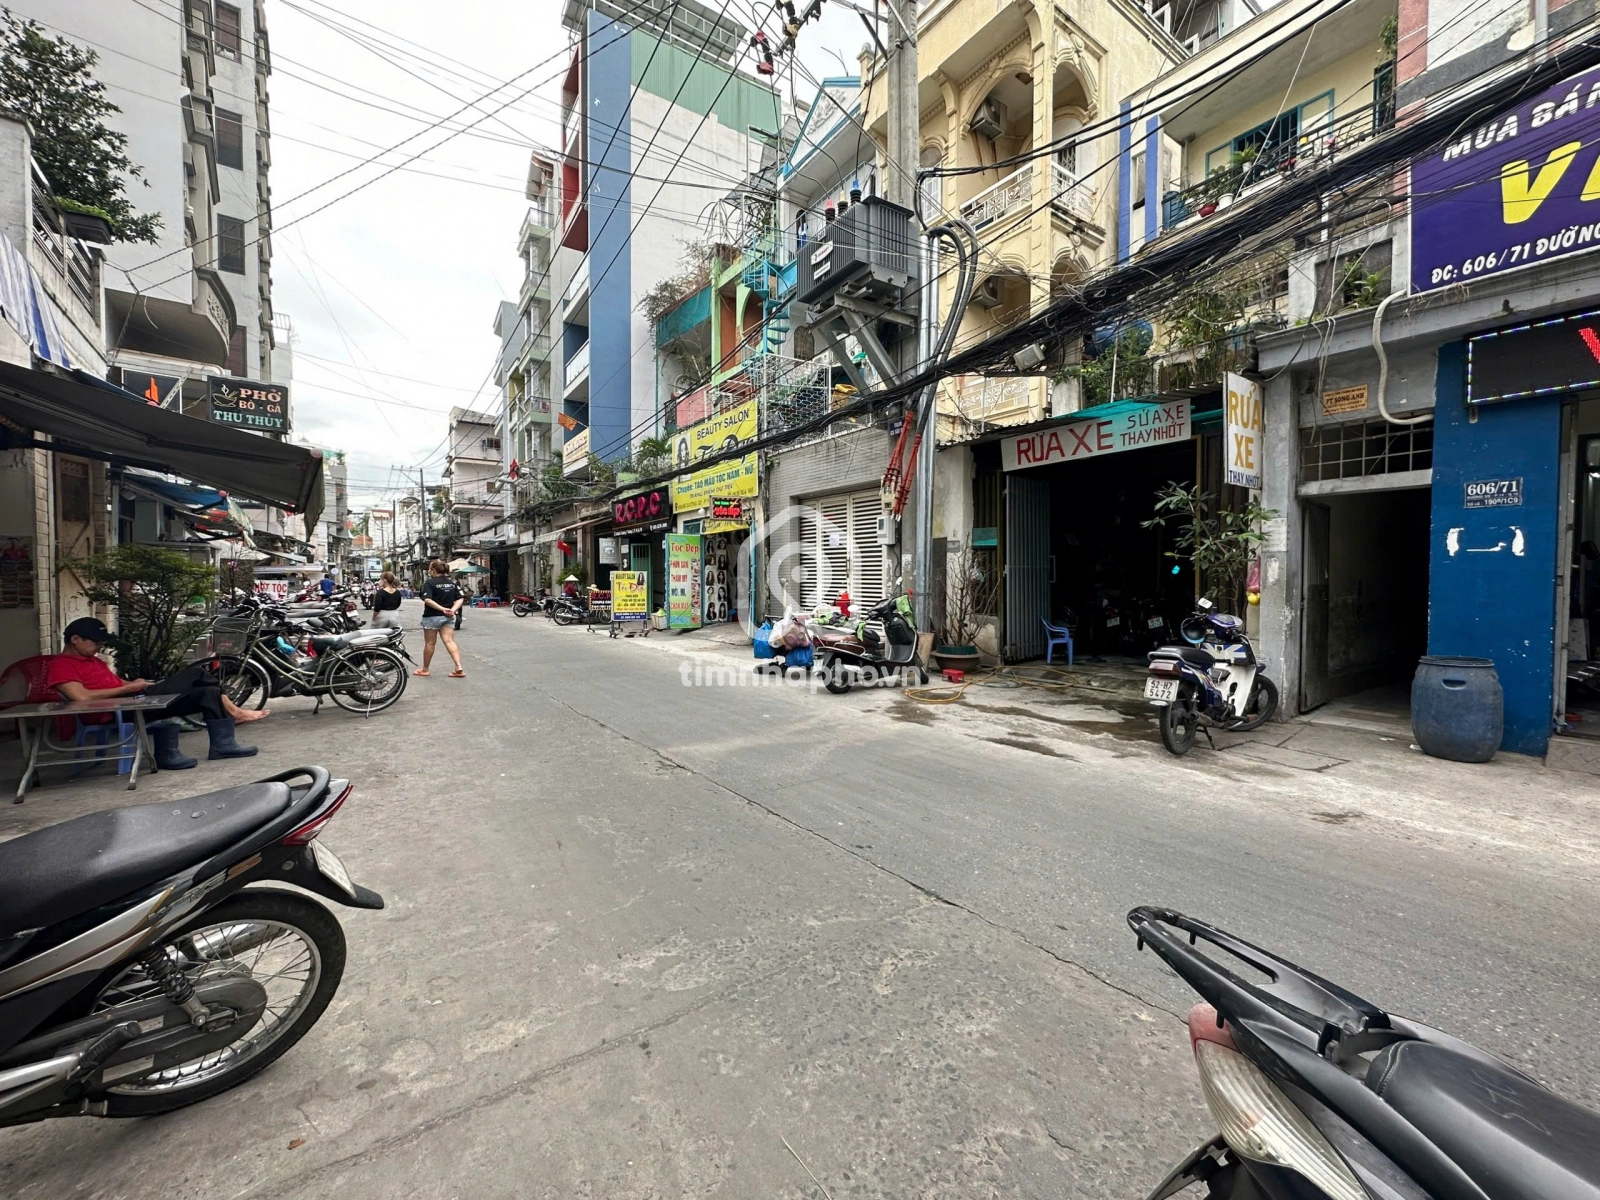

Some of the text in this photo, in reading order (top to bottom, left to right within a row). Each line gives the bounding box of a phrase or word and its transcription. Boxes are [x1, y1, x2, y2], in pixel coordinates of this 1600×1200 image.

[1443, 115, 1518, 162] MUA
[1432, 266, 1458, 283] ĐC:
[1462, 243, 1530, 276] 606/71
[239, 388, 281, 402] PHỞ
[239, 400, 255, 410] BÒ
[267, 404, 281, 413] GÀ
[1162, 404, 1184, 422] XE
[1229, 383, 1261, 433] RỬA
[214, 410, 283, 427] THU THỦY
[697, 408, 749, 440] BEAUTY SALON
[1017, 419, 1113, 465] RỬA XE
[1120, 421, 1185, 446] THAY NHỚT
[1234, 433, 1254, 469] XE
[1229, 470, 1244, 484] THAY
[1467, 480, 1518, 495] 606/71
[1150, 689, 1171, 699] 5472
[1151, 681, 1172, 690] 52-H7
